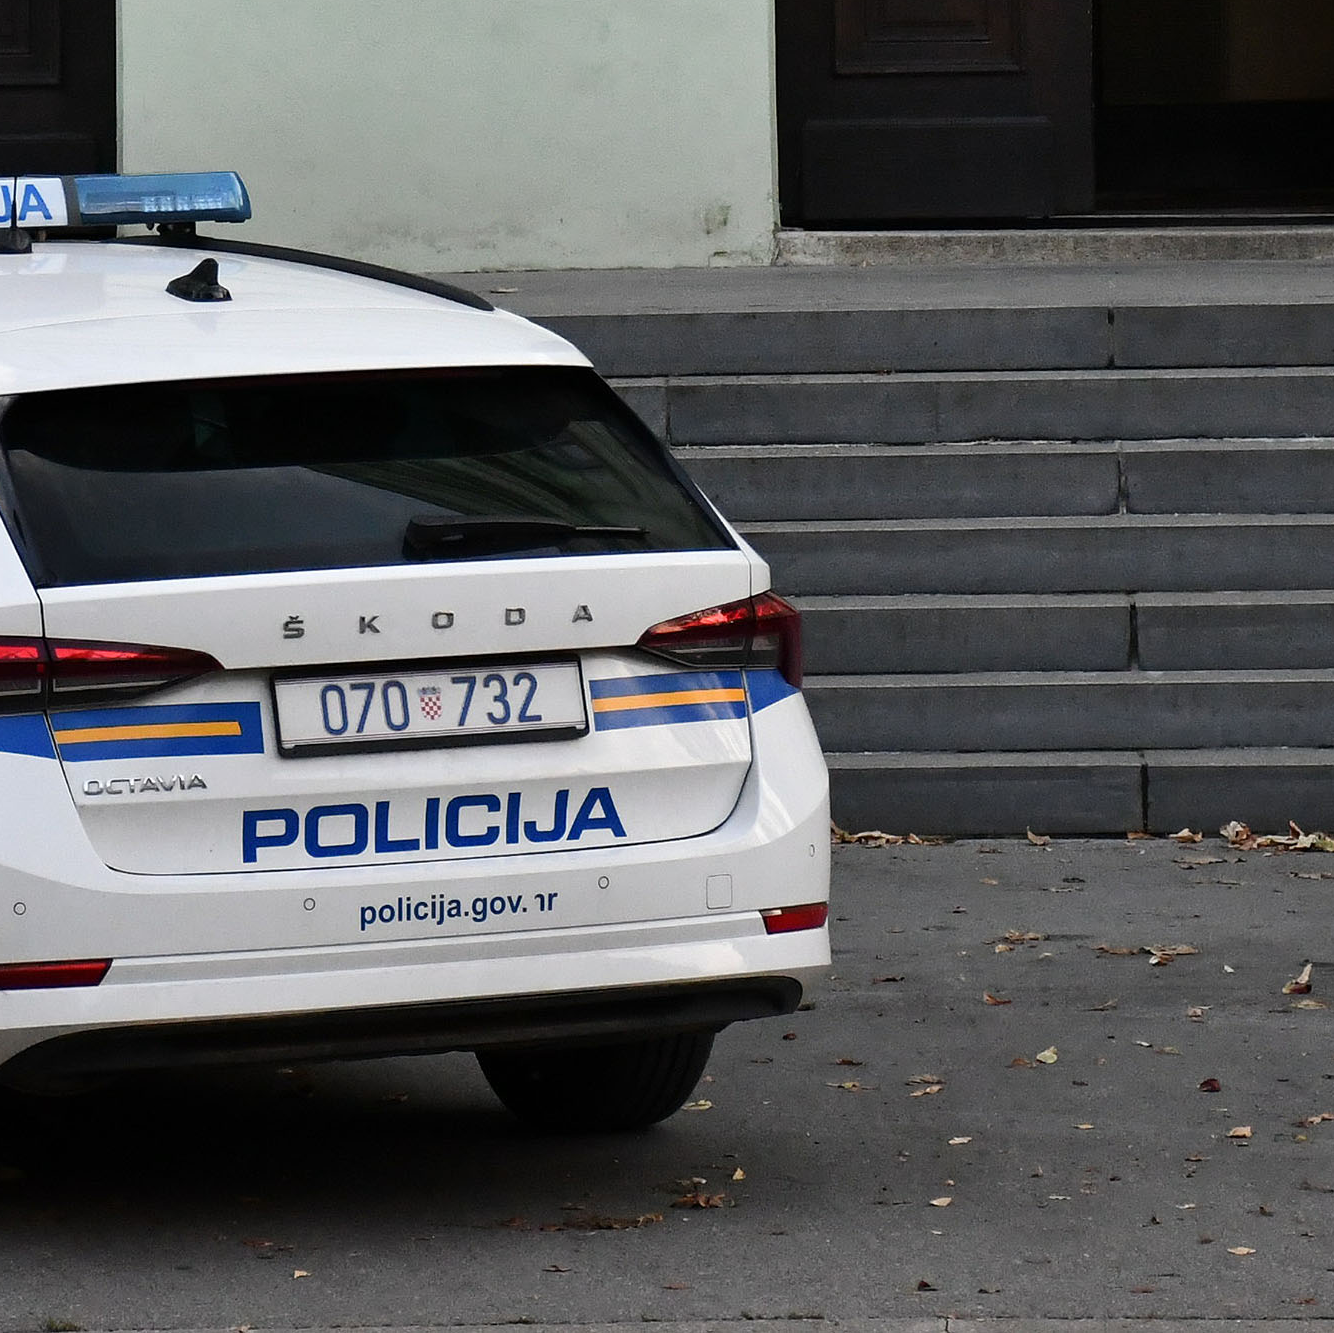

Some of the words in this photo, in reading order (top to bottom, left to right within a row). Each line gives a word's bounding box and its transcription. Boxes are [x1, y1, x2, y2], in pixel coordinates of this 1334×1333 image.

[282, 604, 594, 640] ŠKODA
[320, 679, 410, 735] 070
[450, 672, 542, 726] 732
[83, 774, 208, 795] OCTAVIA
[242, 787, 627, 863] POLICIJA
